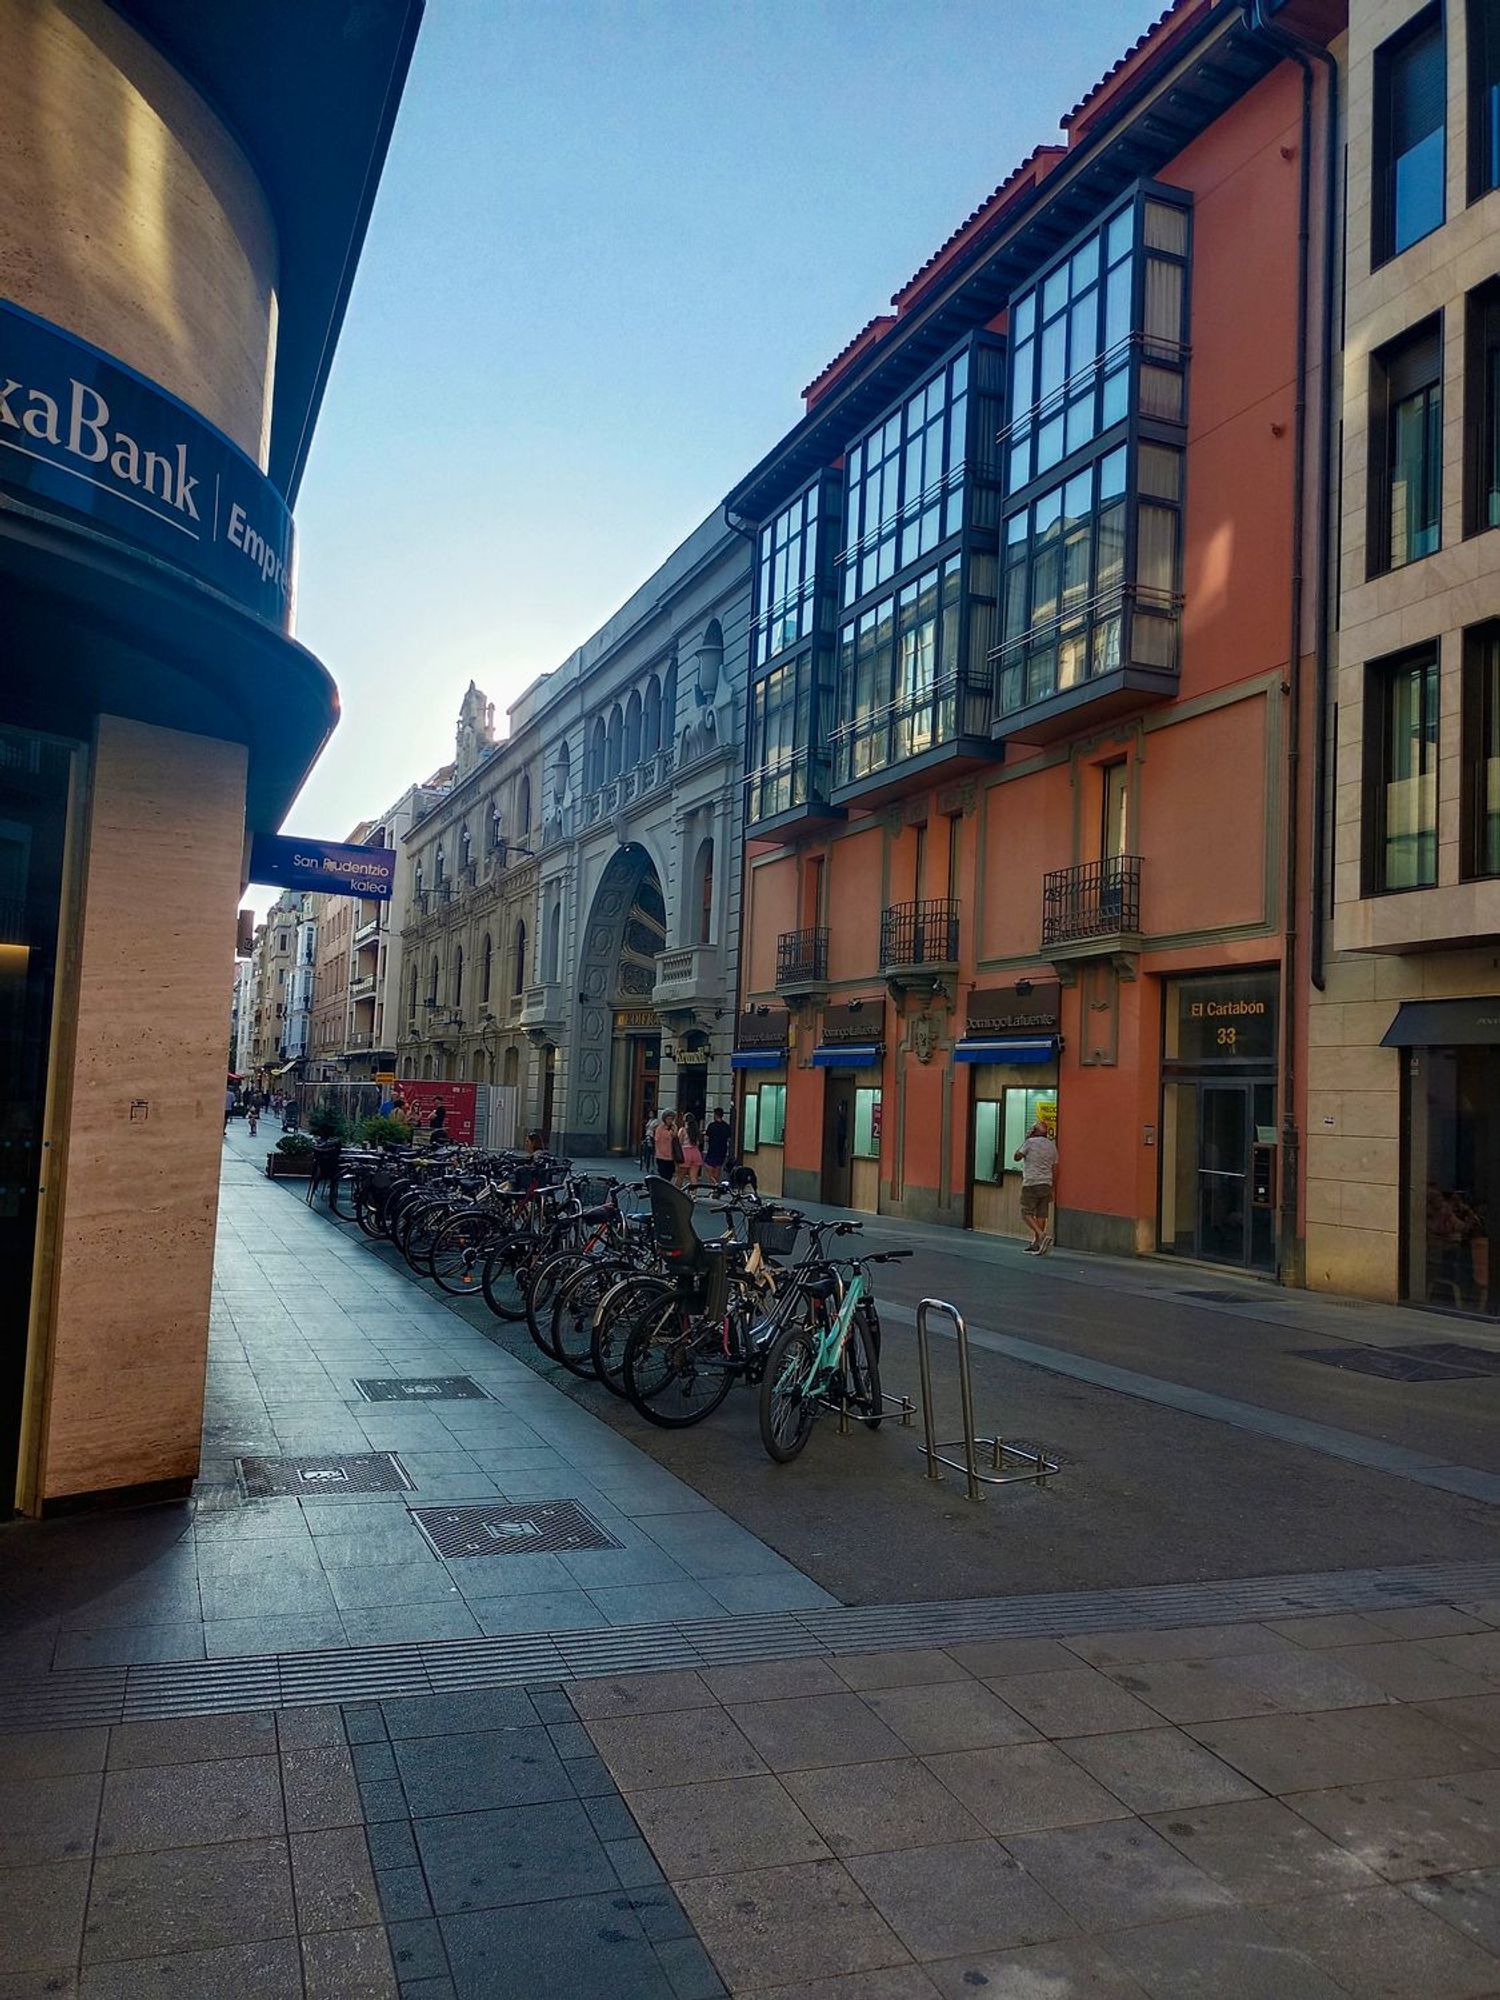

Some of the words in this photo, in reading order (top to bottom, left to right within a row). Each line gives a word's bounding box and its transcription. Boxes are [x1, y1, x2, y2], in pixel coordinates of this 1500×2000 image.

[293, 854, 319, 868] San
[322, 857, 390, 877] Pudentzio
[350, 879, 387, 894] kalea
[1191, 1002, 1203, 1017] El
[1206, 1000, 1265, 1016] Cartabón
[1216, 1027, 1237, 1045] 33
